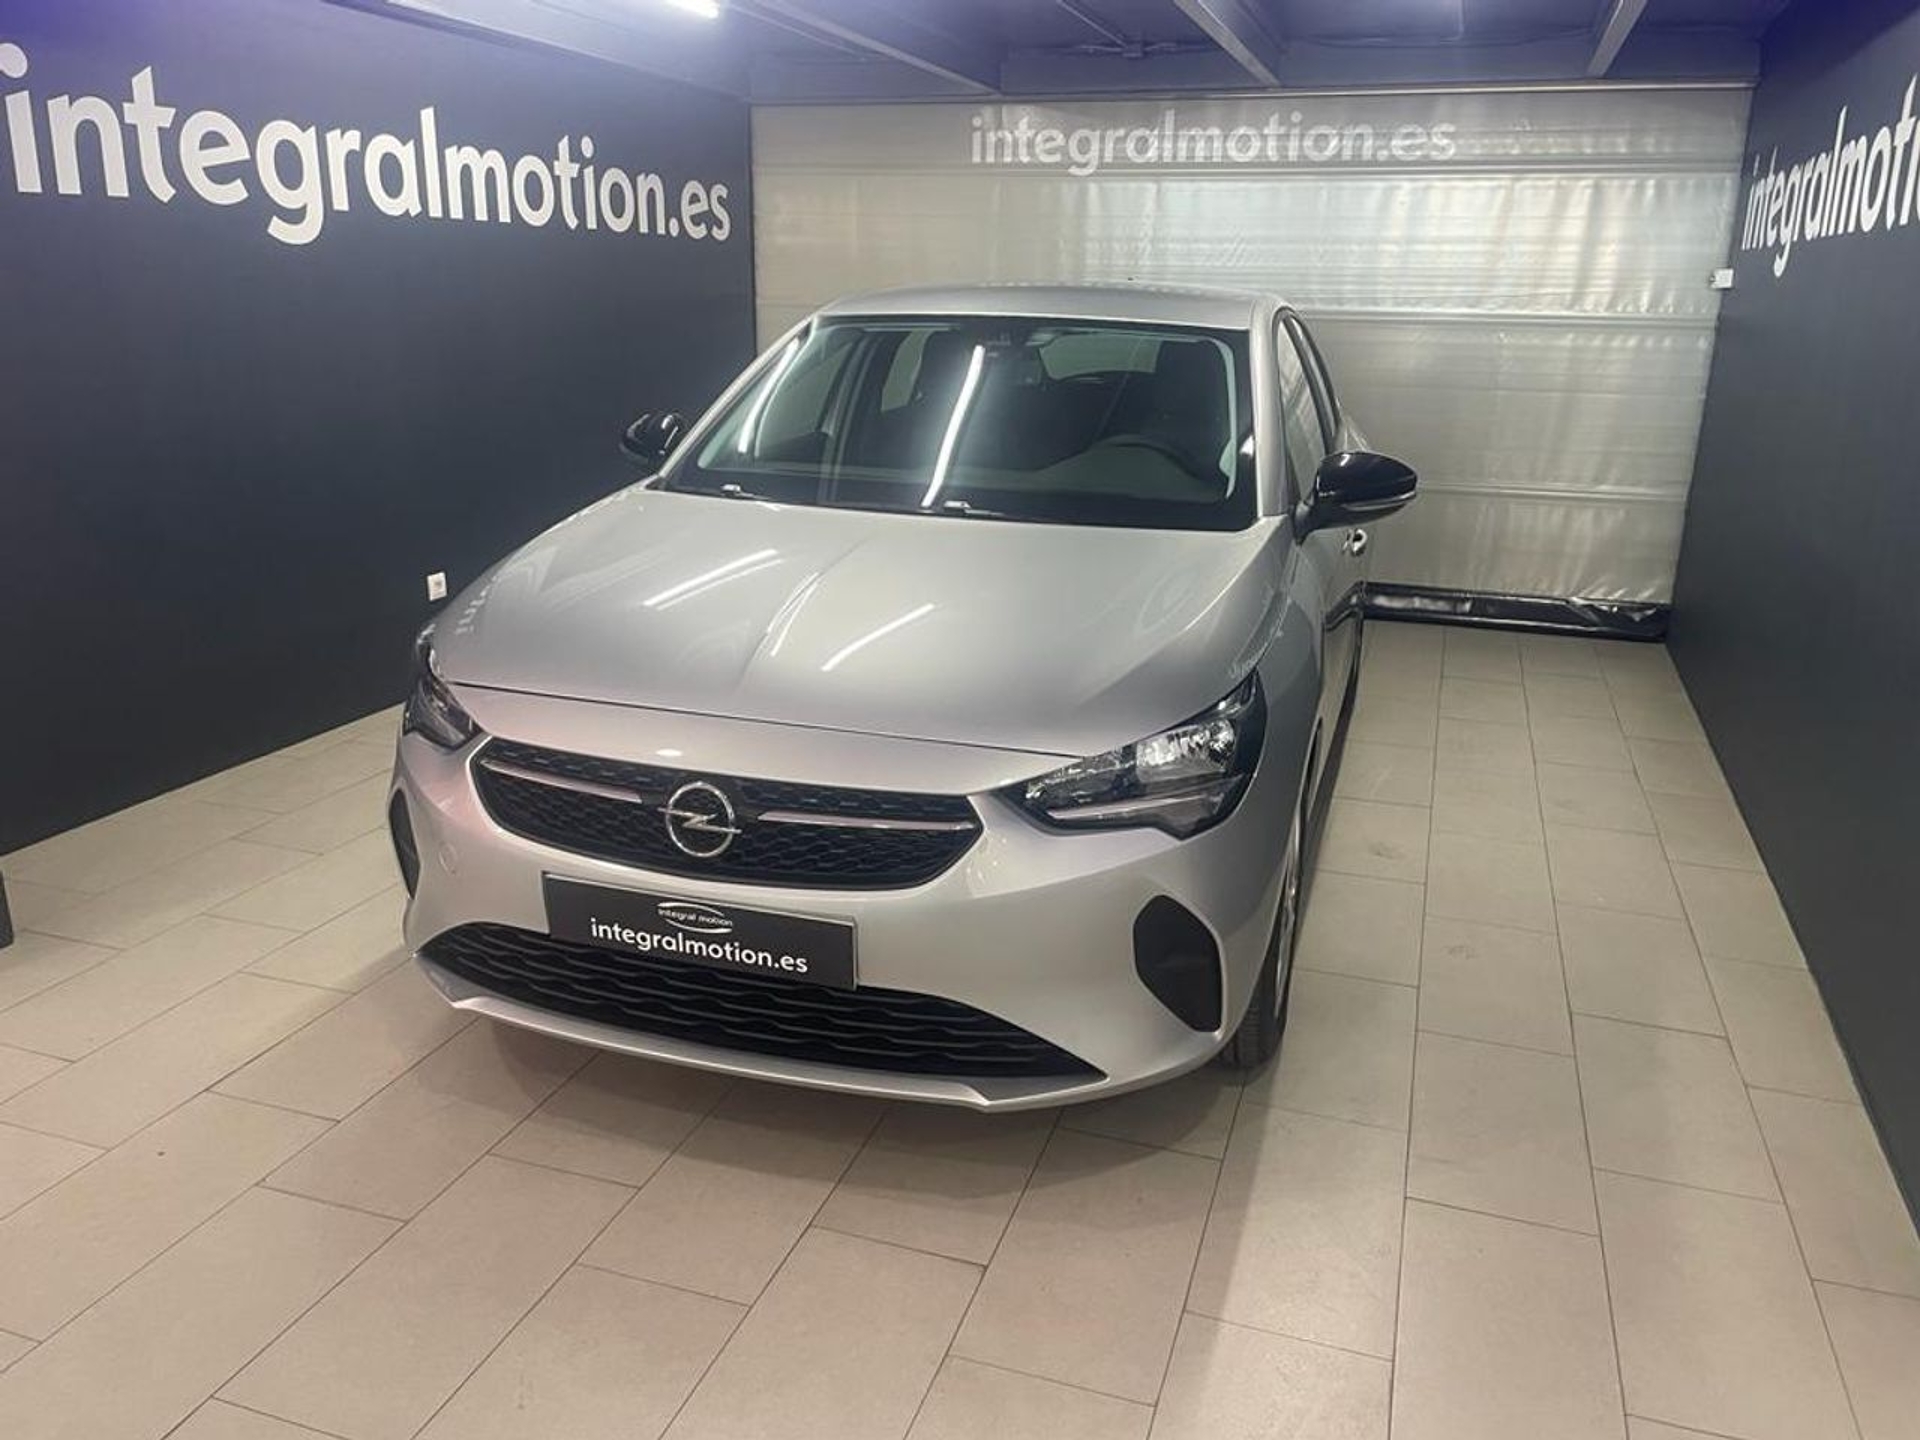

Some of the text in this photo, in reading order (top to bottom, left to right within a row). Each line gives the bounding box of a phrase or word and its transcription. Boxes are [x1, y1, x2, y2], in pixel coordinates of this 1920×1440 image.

[0, 43, 731, 245] integralmotion.es
[971, 110, 1457, 176] integralmotion.es
[1742, 73, 1920, 277] integralmoti
[590, 917, 808, 973] integralmotion.es
[657, 908, 733, 927] integral motion
